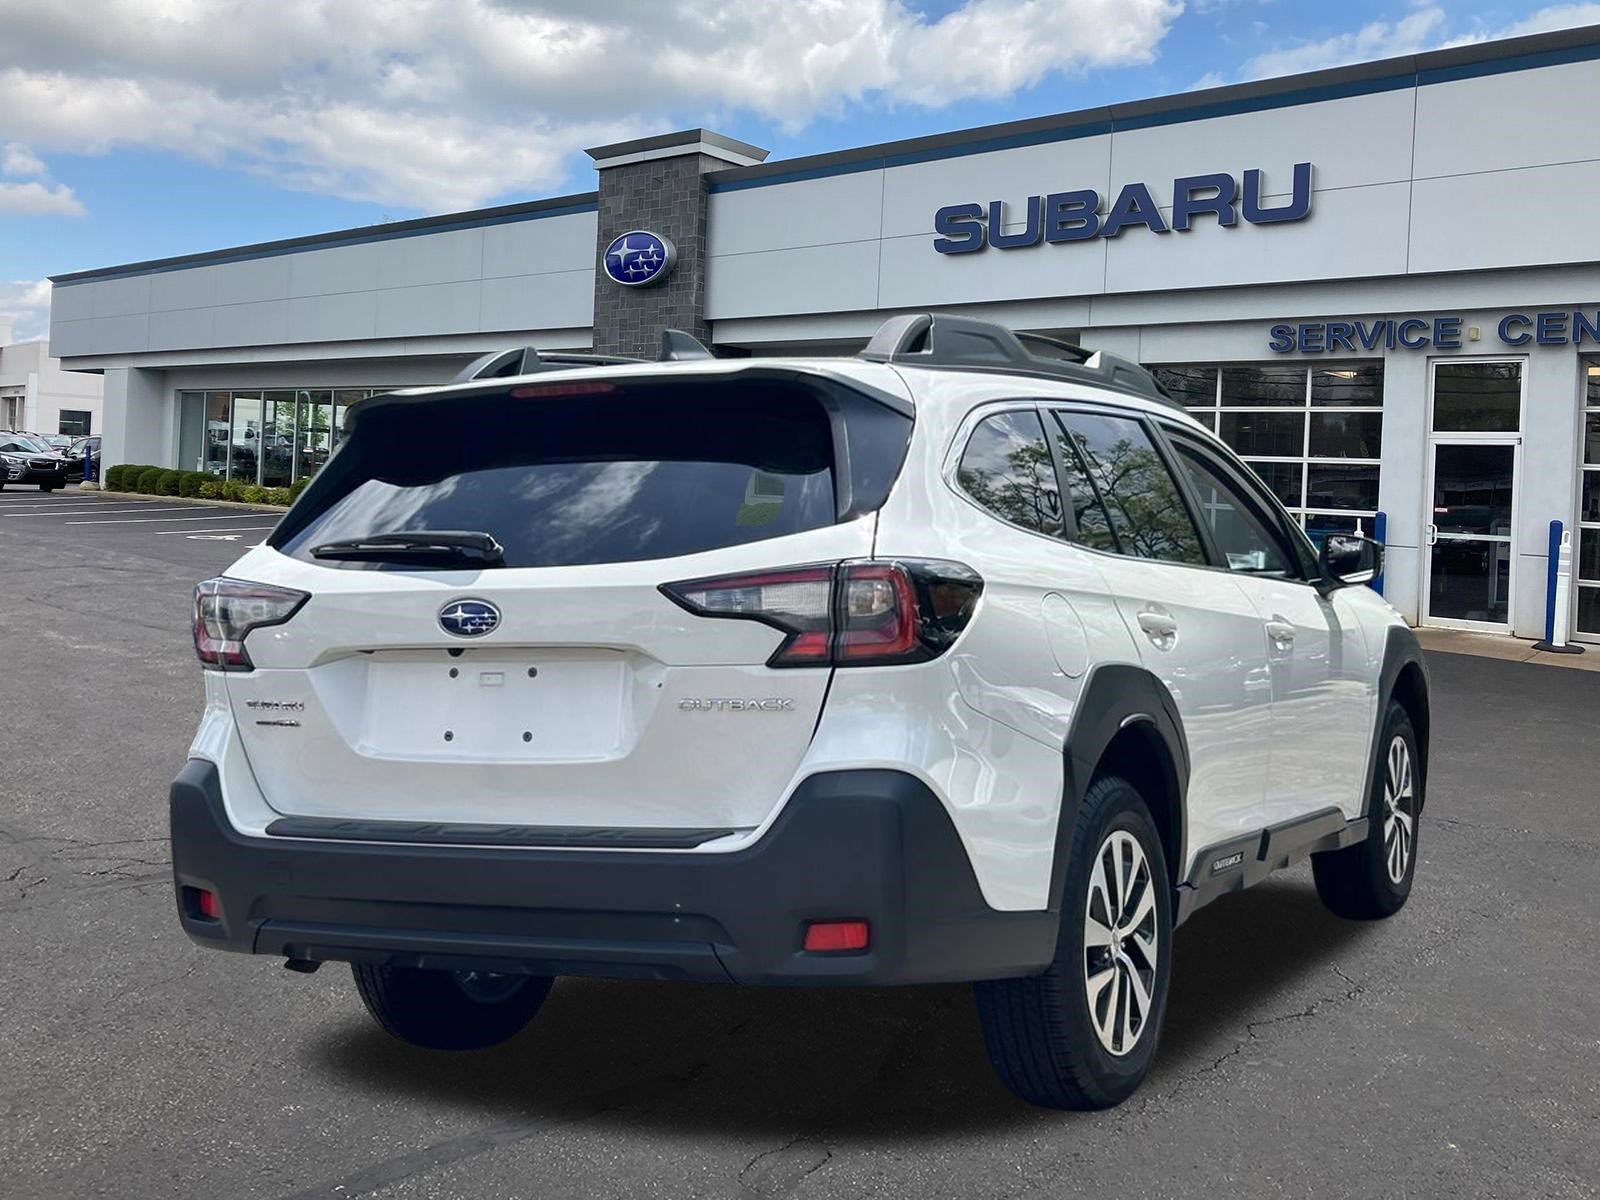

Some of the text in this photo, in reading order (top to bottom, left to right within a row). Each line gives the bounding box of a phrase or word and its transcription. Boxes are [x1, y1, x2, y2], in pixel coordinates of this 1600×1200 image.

[934, 162, 1312, 255] SUBARU
[1269, 317, 1463, 353] SERVICE
[679, 698, 795, 712] OUTBACK
